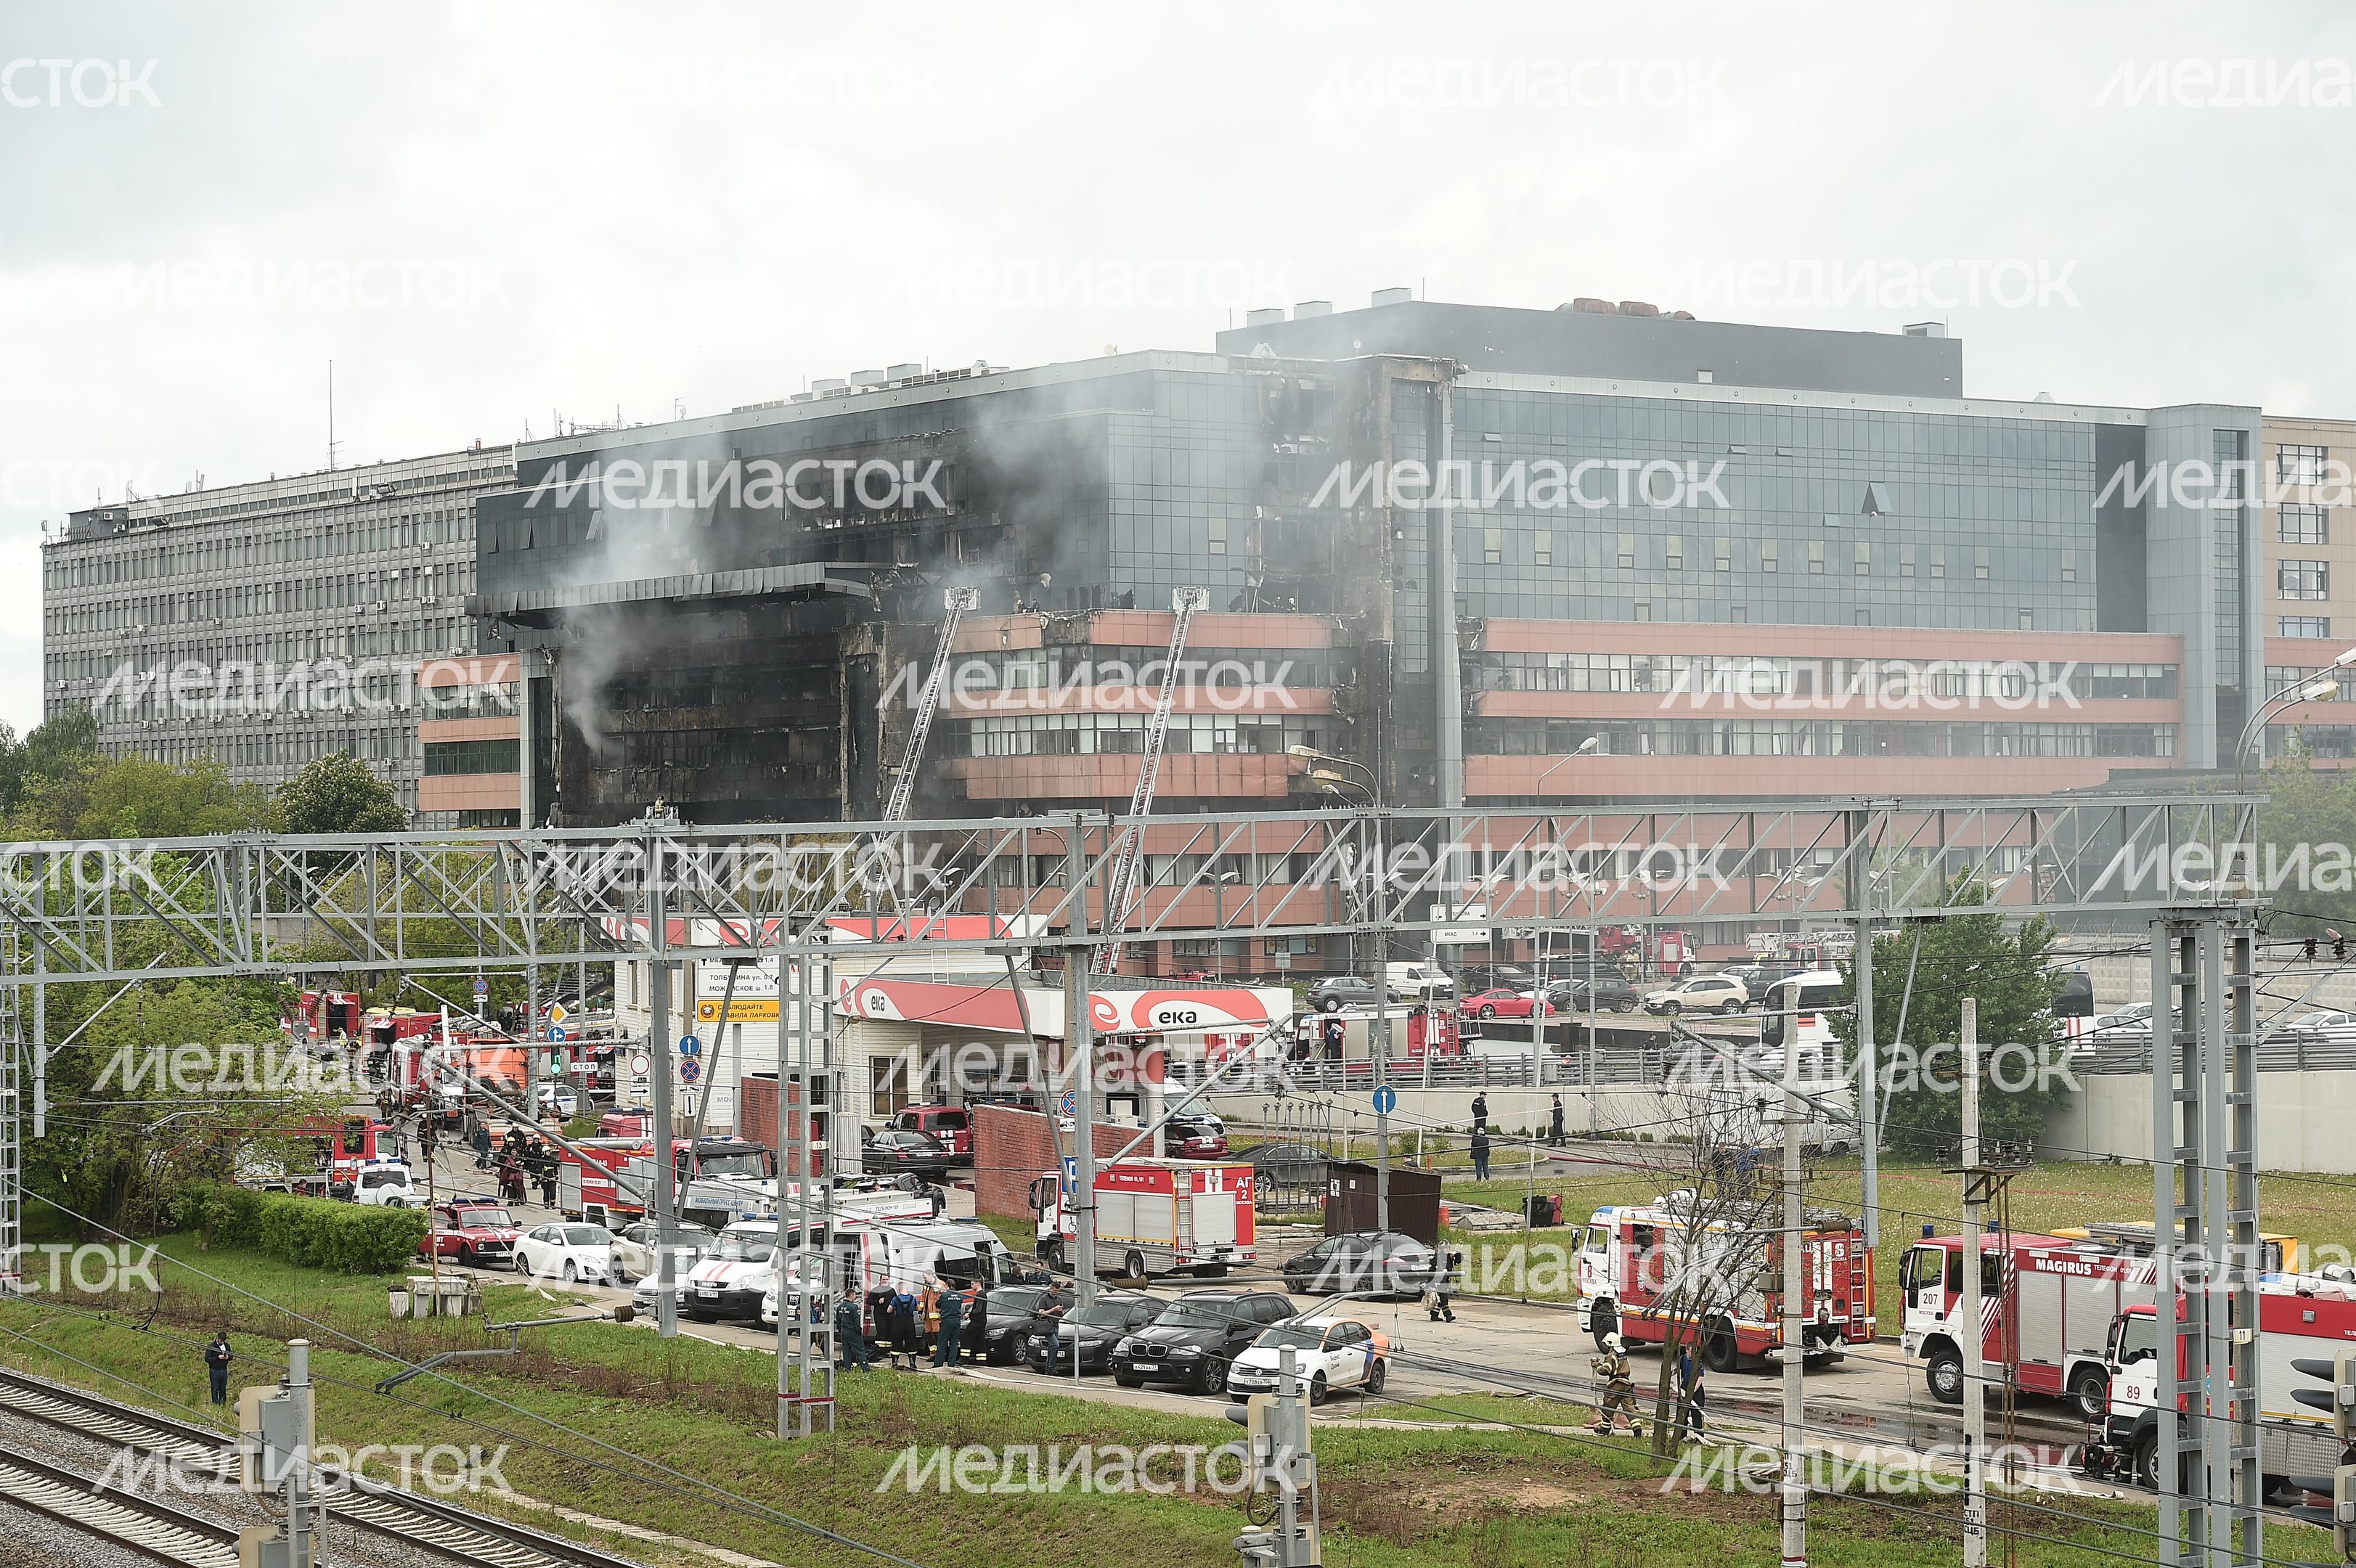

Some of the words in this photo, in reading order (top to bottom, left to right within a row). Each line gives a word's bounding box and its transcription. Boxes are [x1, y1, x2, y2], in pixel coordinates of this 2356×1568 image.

[1236, 1176, 1252, 1188] АГ
[1241, 1189, 1247, 1199] 2
[1587, 1265, 1592, 1278] 8
[2035, 1258, 2092, 1275] MAGIRUS
[2094, 1264, 2117, 1273] ТЕЛЕФОН
[1923, 1293, 1939, 1305] 207
[2238, 1330, 2246, 1341] 11
[2127, 1385, 2140, 1400] 89
